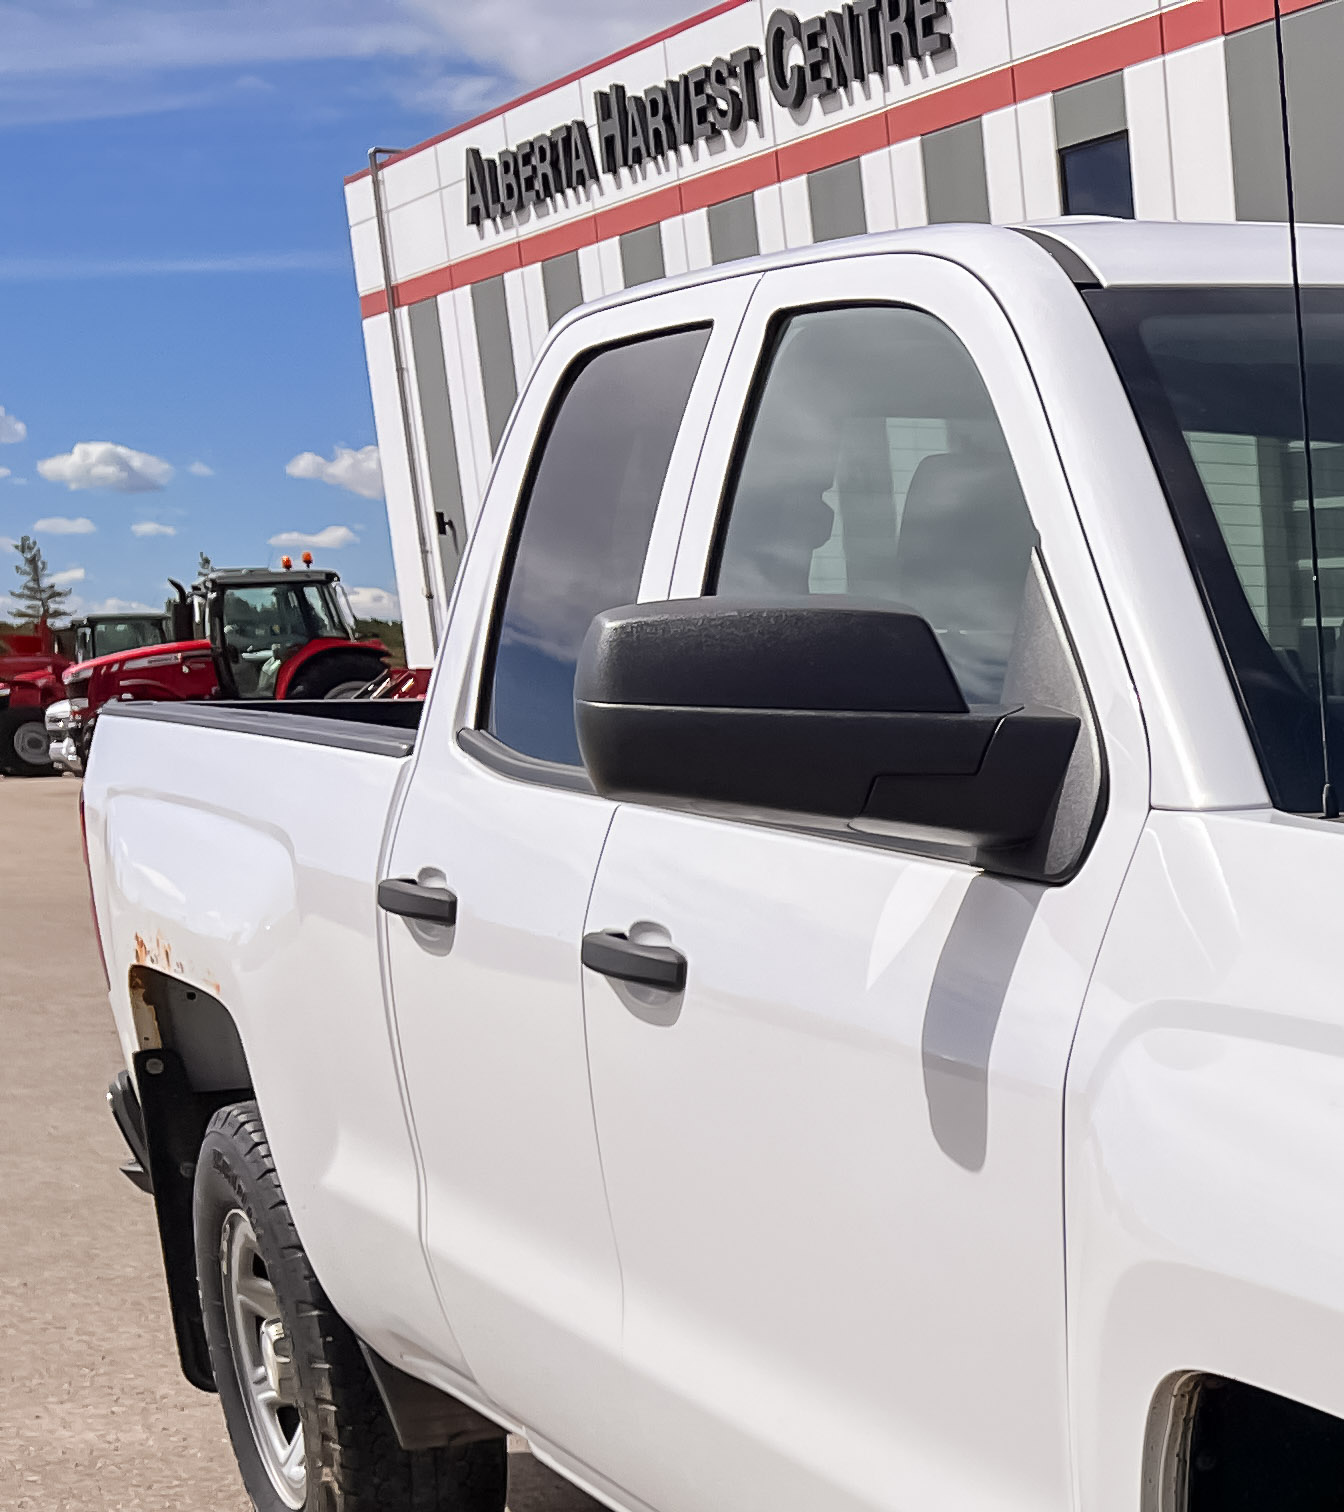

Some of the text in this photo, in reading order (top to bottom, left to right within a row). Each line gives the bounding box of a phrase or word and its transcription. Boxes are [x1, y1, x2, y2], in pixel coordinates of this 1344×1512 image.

[466, 0, 952, 227] ALBERTA HARVEST CENTRE
